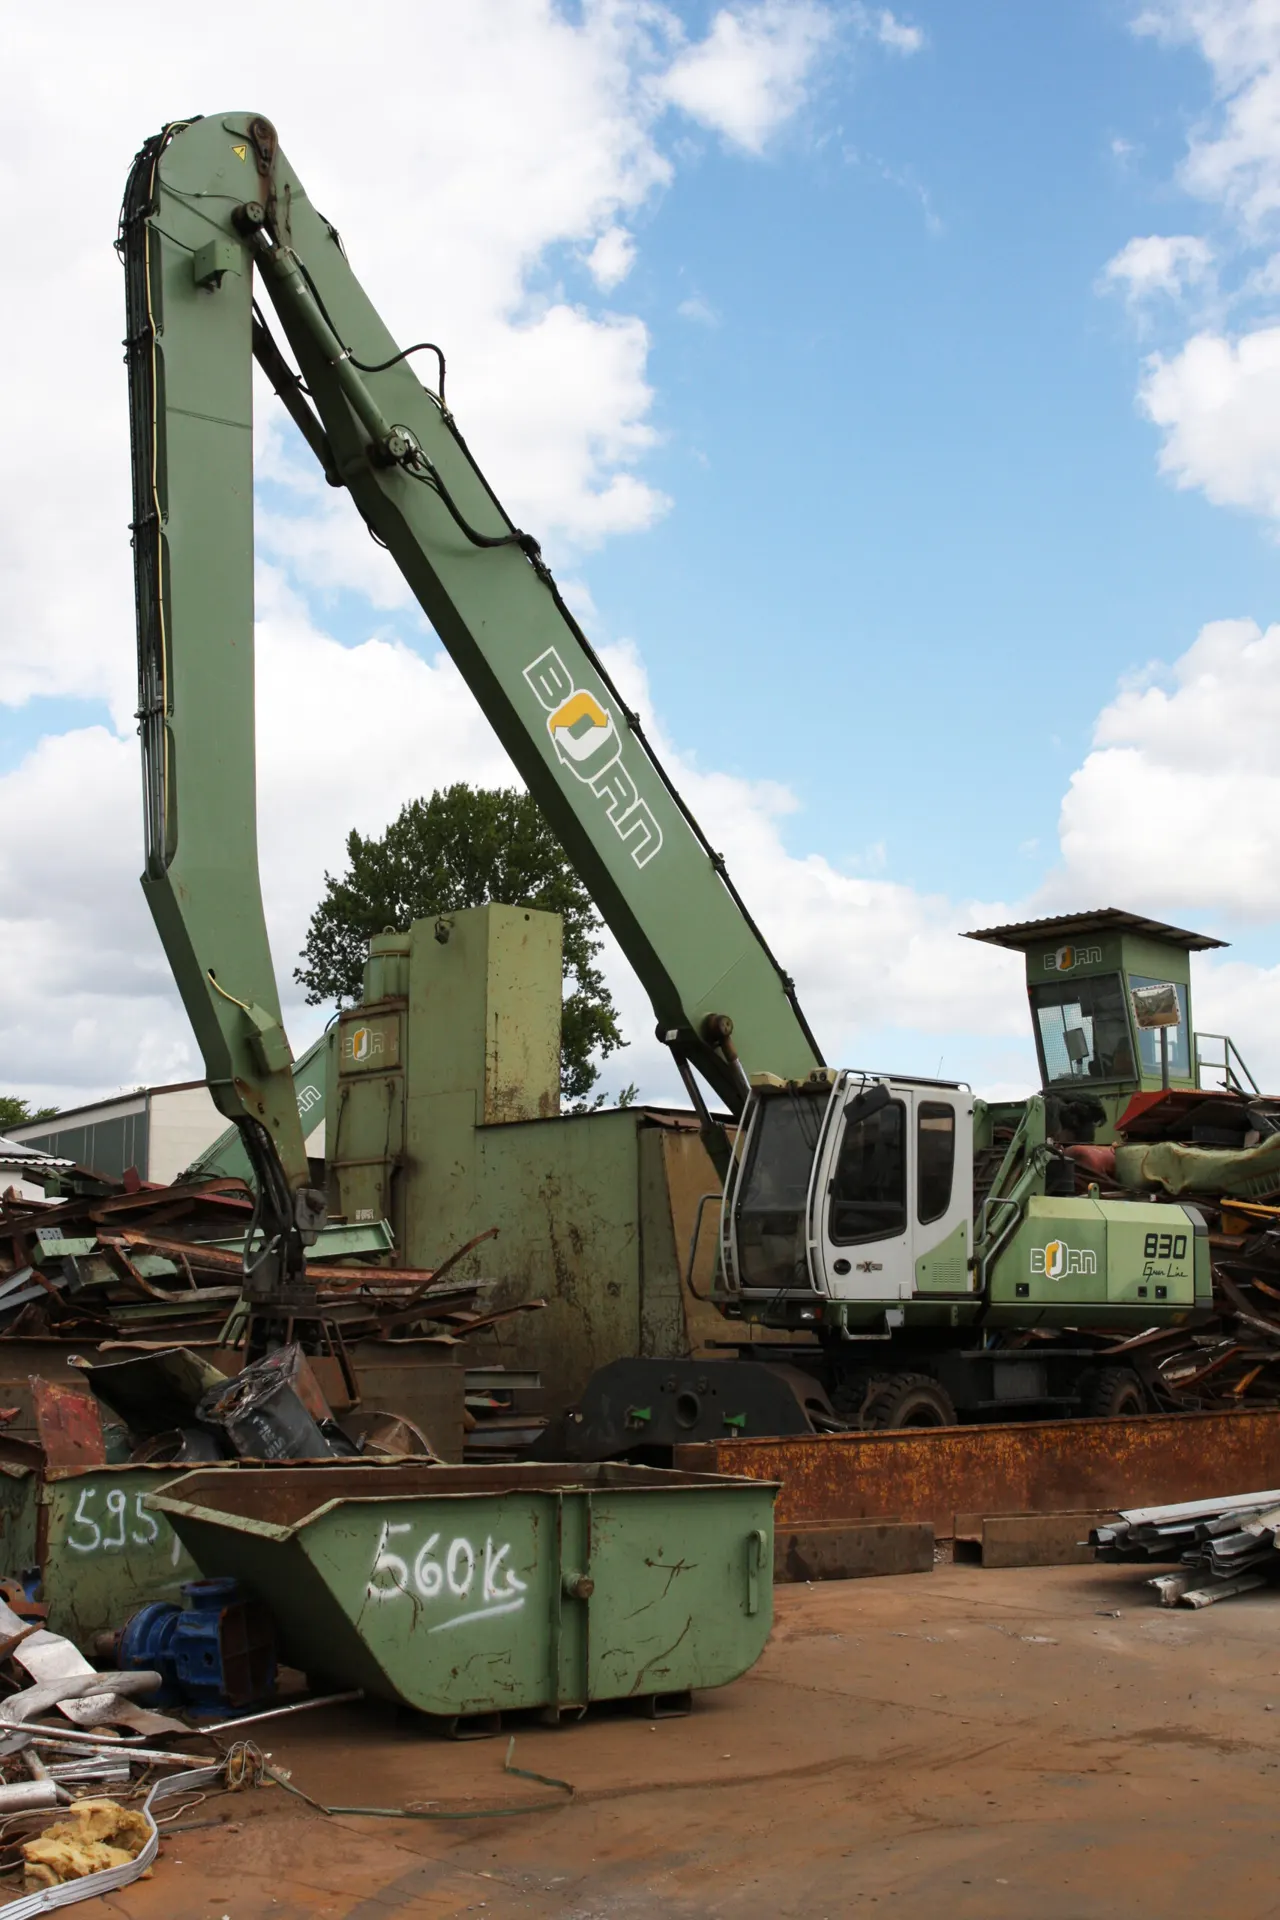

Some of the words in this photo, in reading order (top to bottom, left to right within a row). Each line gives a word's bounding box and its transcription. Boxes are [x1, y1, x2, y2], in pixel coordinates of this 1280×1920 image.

[522, 645, 664, 870] BORN
[1043, 945, 1102, 972] BORN
[1143, 1233, 1187, 1260] 830
[1030, 1239, 1097, 1282] BORN
[1167, 1262, 1189, 1278] Line
